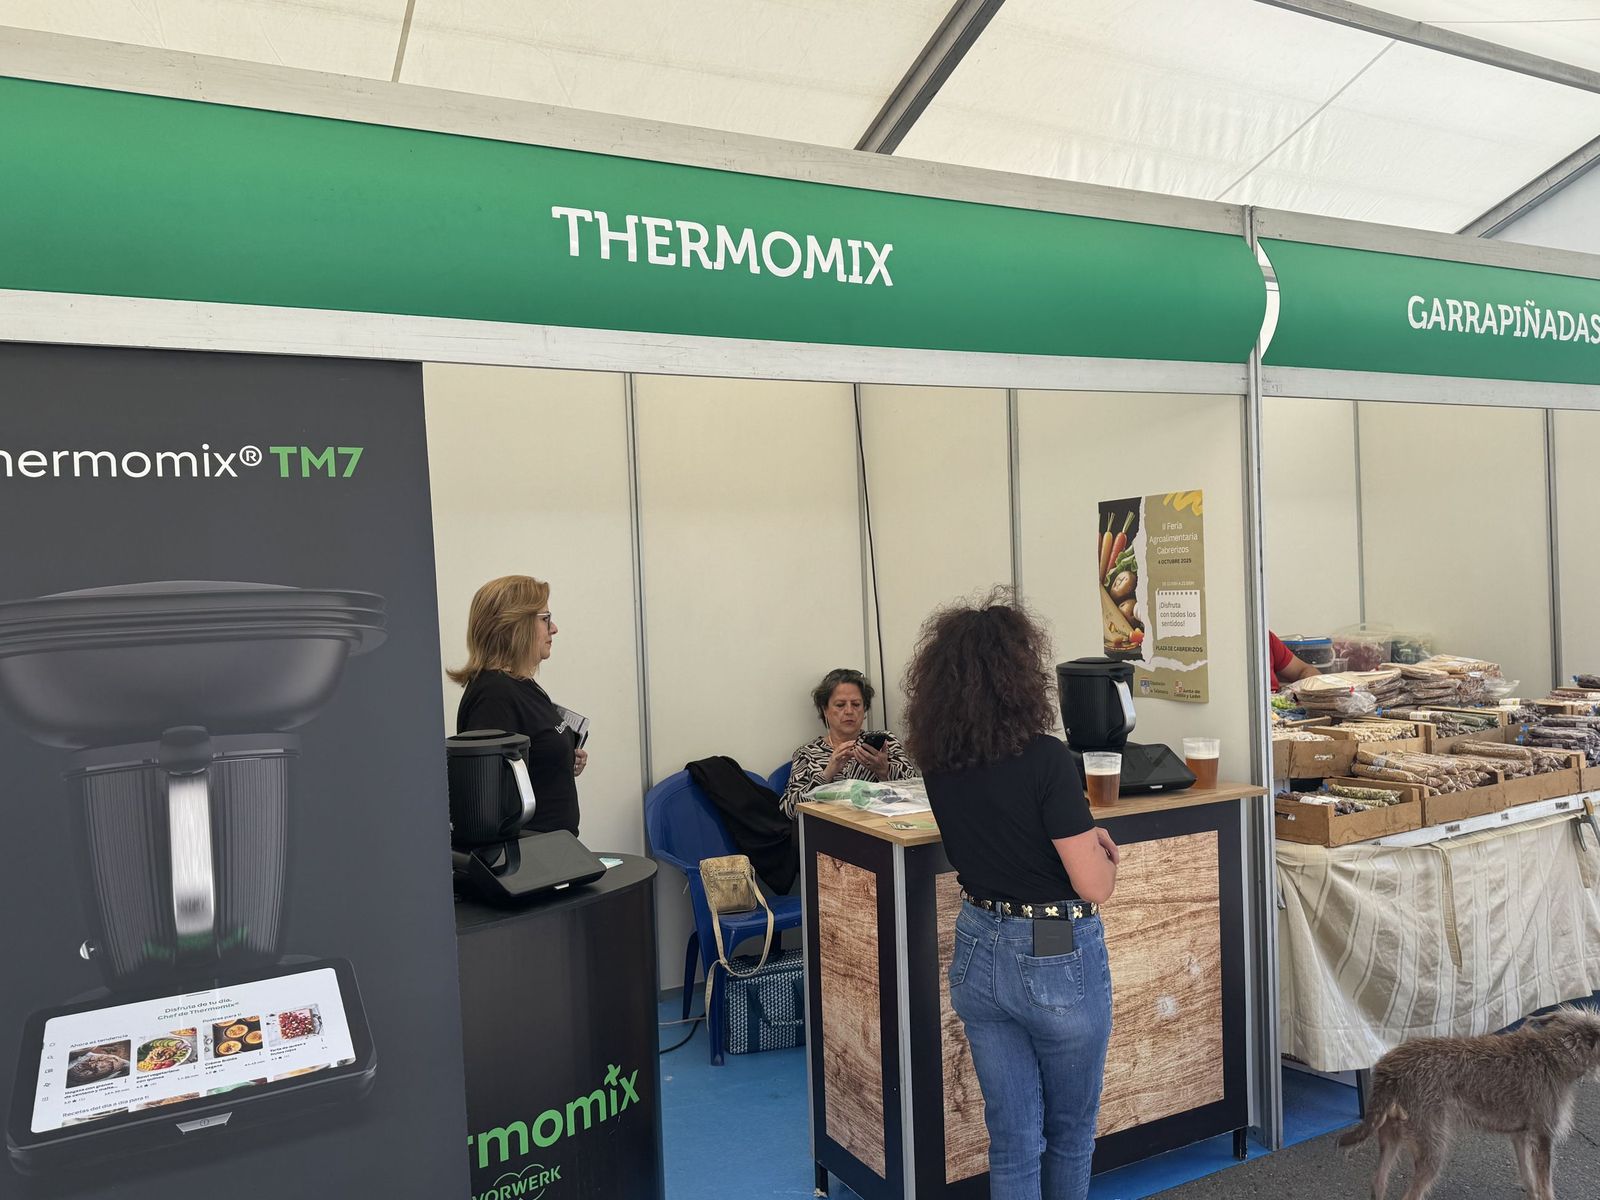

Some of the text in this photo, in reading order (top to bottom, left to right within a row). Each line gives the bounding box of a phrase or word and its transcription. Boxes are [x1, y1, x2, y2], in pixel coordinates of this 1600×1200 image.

[551, 206, 894, 286] THERMOMIX
[1407, 295, 1600, 345] GARRAPIÑADAS
[269, 446, 364, 478] TM7
[1167, 521, 1183, 530] Feria
[1149, 532, 1198, 545] Agroalimentaria
[164, 1004, 196, 1014] Disfruta
[157, 1012, 177, 1021] Chef
[62, 1107, 90, 1118] Recetas
